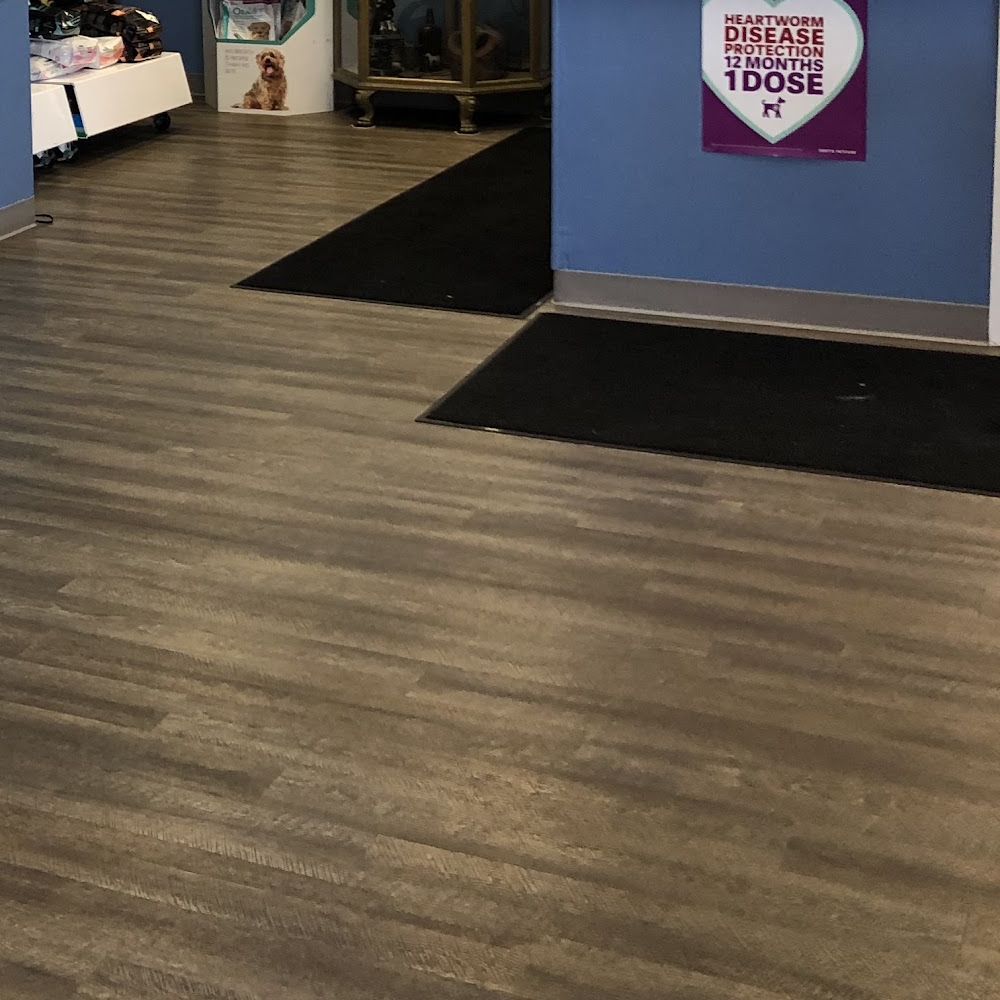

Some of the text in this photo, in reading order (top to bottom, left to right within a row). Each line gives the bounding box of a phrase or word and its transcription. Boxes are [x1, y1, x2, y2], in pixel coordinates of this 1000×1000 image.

[724, 14, 824, 27] HEARTWORM
[724, 26, 824, 45] DISEASE
[724, 43, 824, 58] PROTECTION
[724, 56, 824, 71] 12 MONTHS
[724, 69, 824, 95] 1 DOSE
